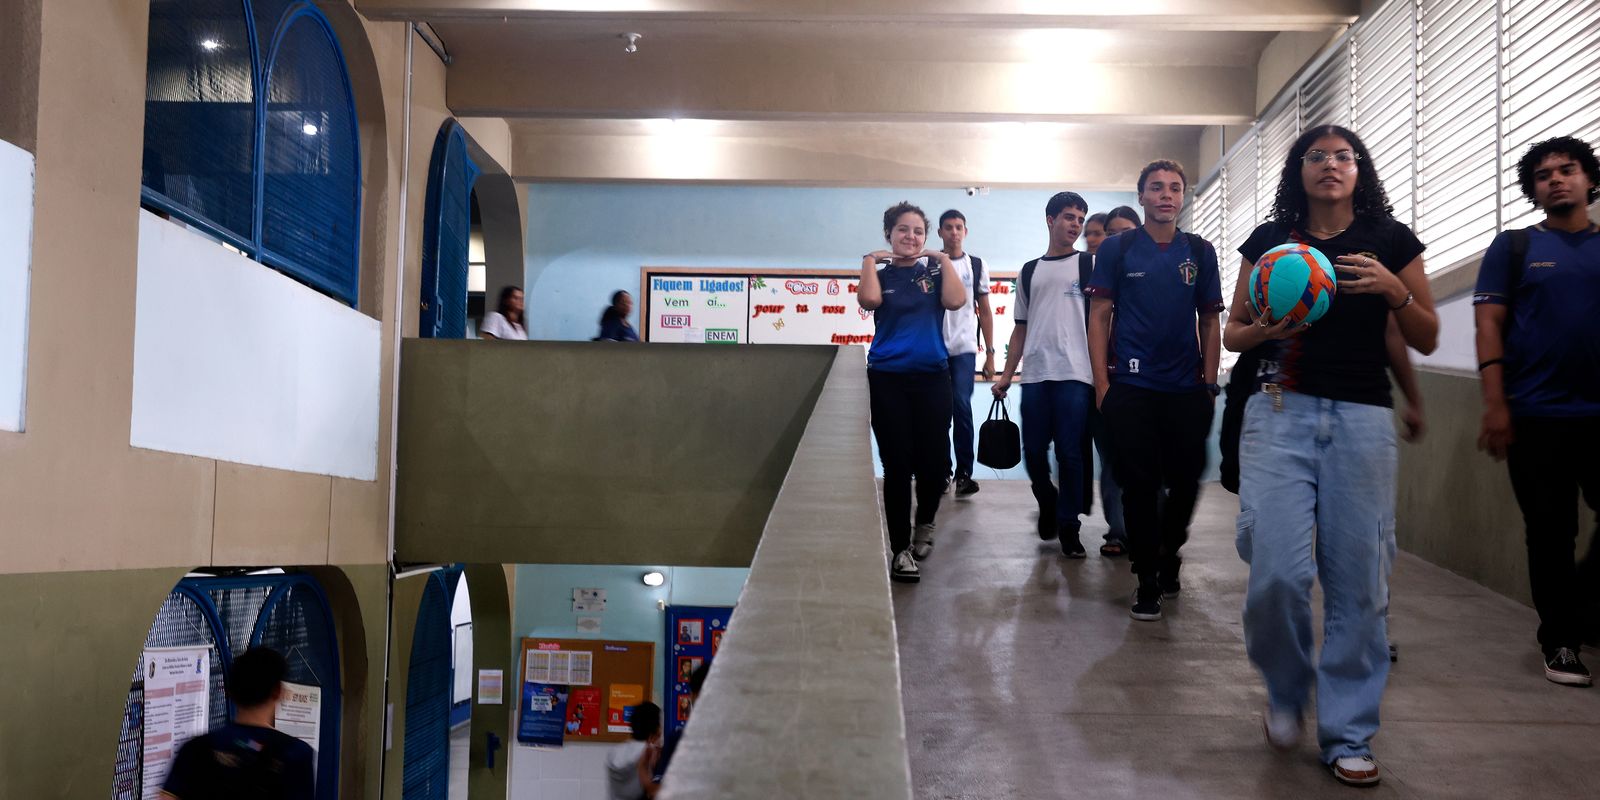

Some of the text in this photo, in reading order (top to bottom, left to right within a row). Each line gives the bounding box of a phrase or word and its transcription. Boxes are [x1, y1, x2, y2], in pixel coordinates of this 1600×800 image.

[653, 279, 744, 293] Fiquem Ligados!
[847, 283, 859, 293] te
[664, 298, 689, 307] Vem
[752, 304, 785, 318] pour
[796, 304, 809, 313] ta
[822, 305, 846, 314] rose
[995, 306, 1006, 315] si
[664, 317, 688, 326] UERJ
[707, 331, 736, 340] ENEM
[831, 333, 875, 345] import
